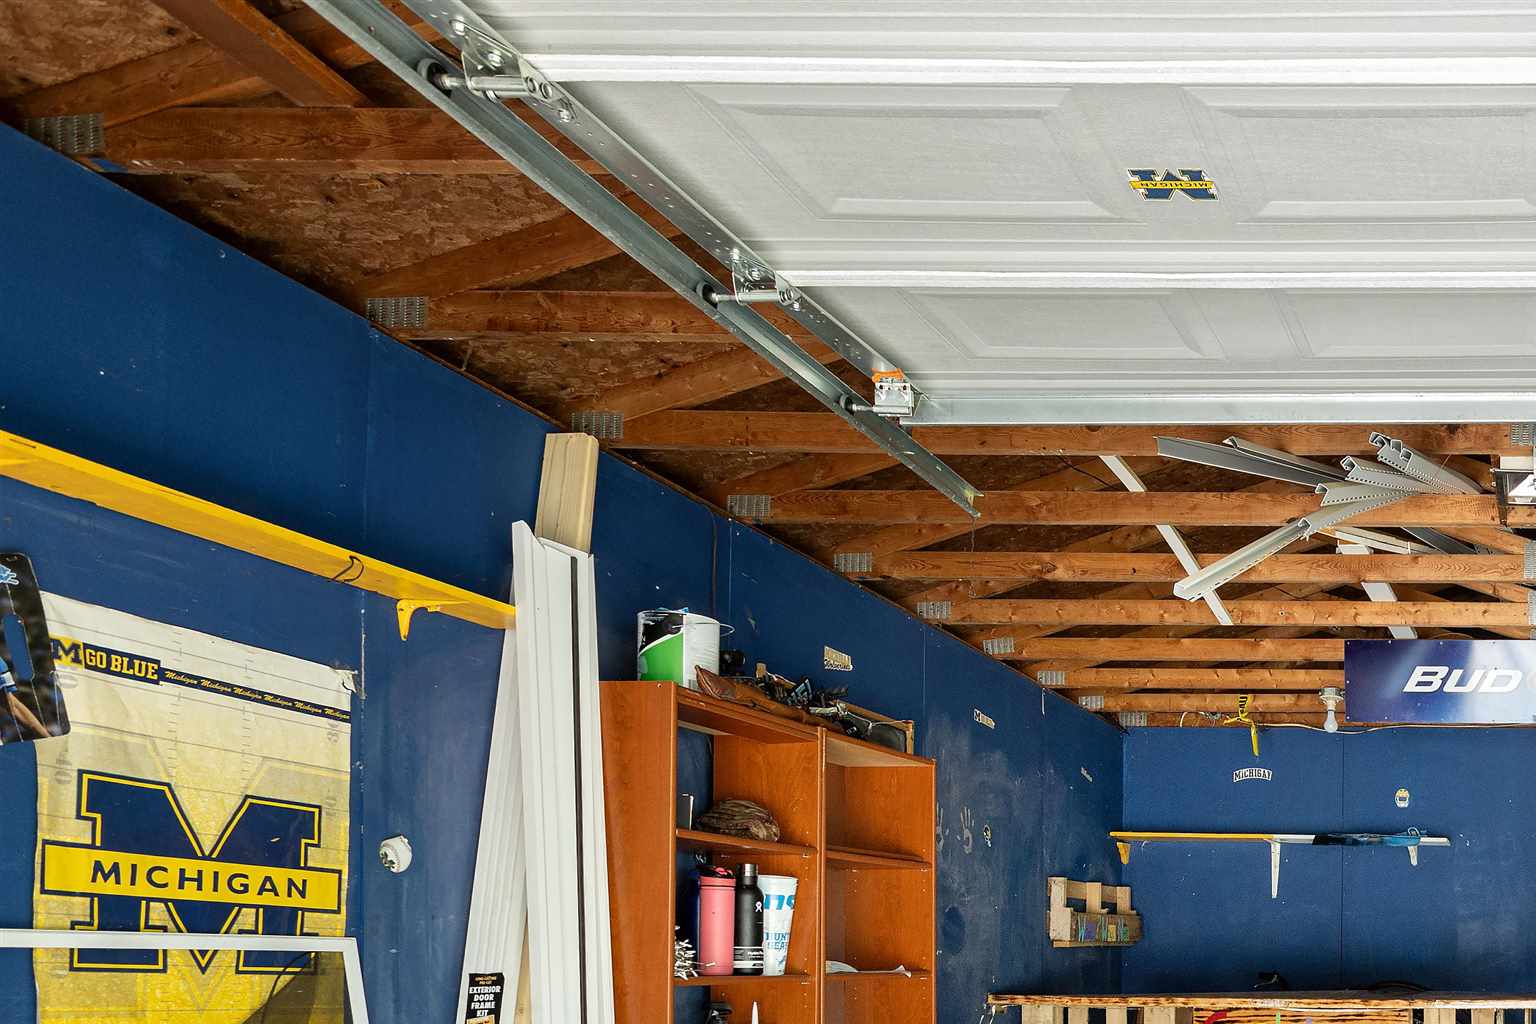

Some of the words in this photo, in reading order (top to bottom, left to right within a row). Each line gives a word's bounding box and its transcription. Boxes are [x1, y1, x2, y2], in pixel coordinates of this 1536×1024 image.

[85, 648, 106, 668] GO
[110, 653, 160, 681] BLUE
[164, 670, 198, 685] Michigan
[200, 678, 232, 693] Michigan
[1402, 665, 1523, 694] BUD
[91, 859, 308, 900] MICHIGAN
[469, 985, 501, 994] EXTERIOR
[474, 994, 495, 1002] DOOR
[476, 1009, 489, 1017] KIT
